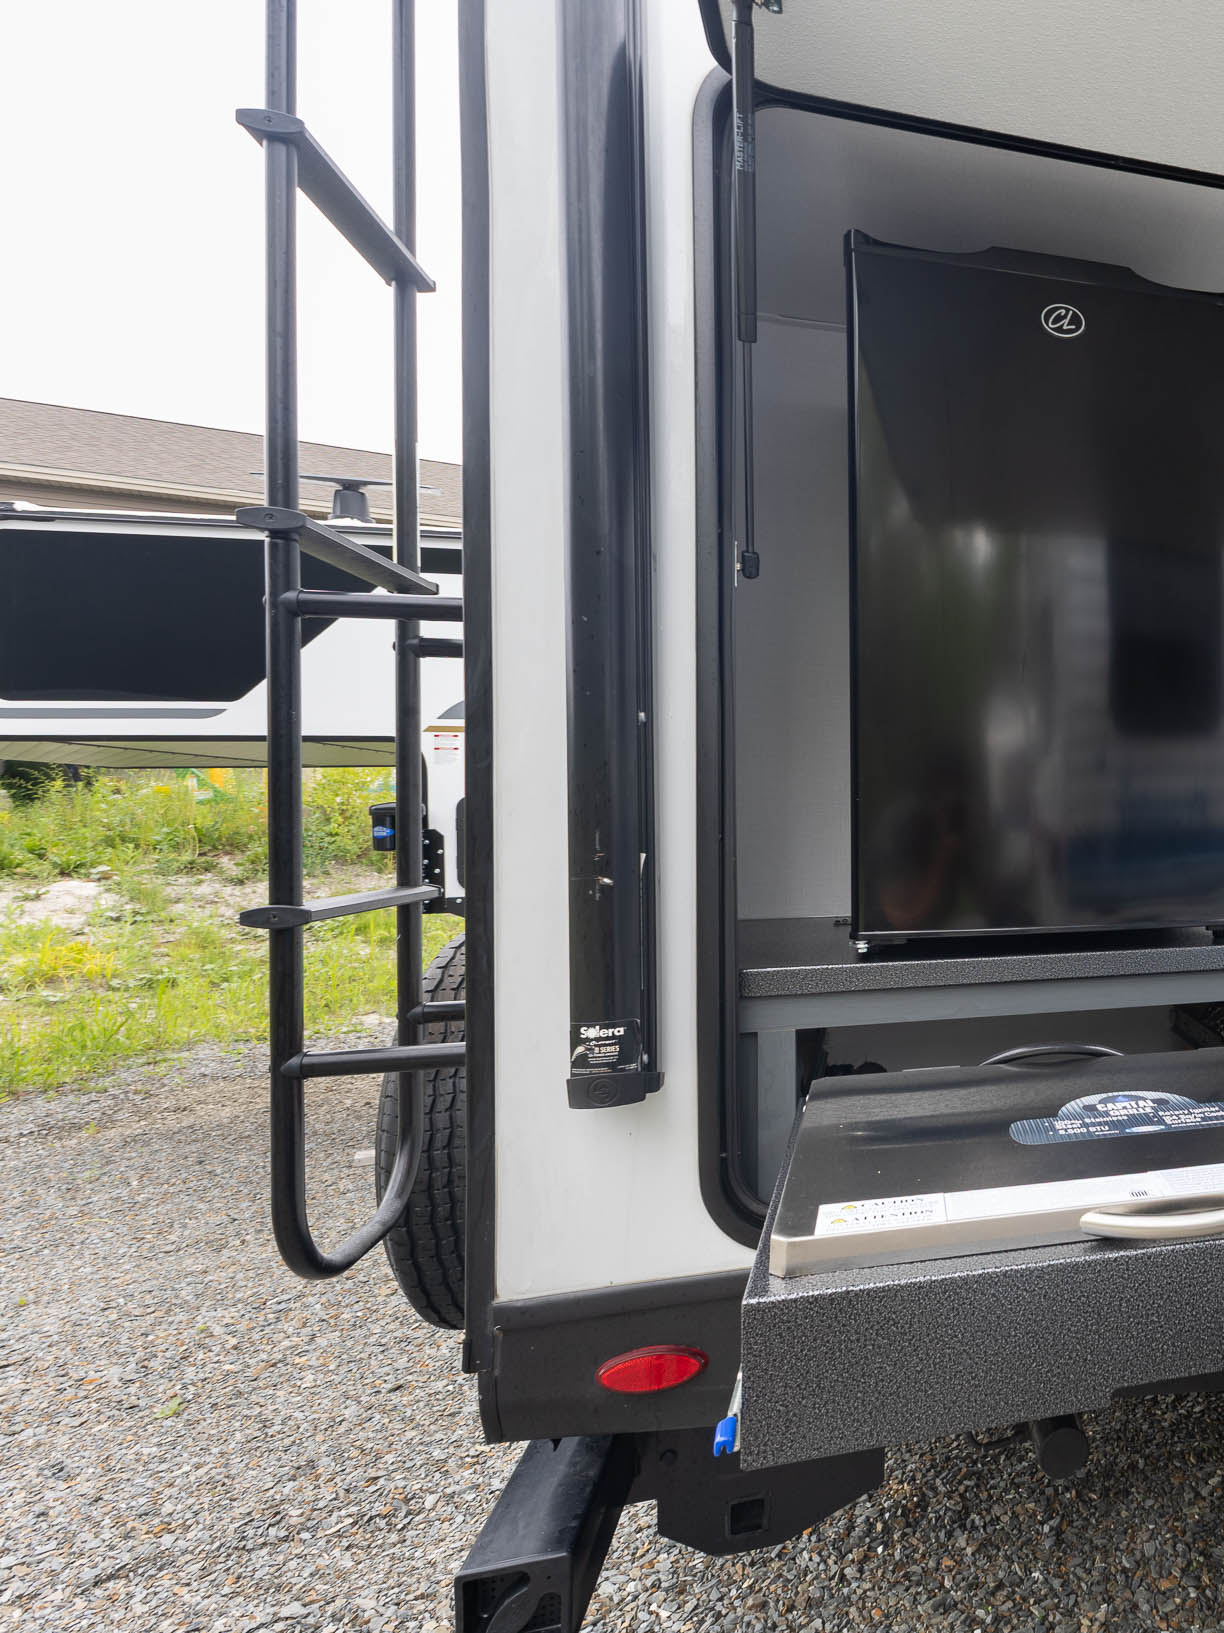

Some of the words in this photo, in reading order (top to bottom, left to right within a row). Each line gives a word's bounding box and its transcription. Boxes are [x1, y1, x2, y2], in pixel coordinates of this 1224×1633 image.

[580, 1025, 624, 1039] Solera
[600, 1045, 620, 1053] SERIES
[1096, 1099, 1158, 1112] CAPITAL
[1109, 1107, 1154, 1116] GRILLE
